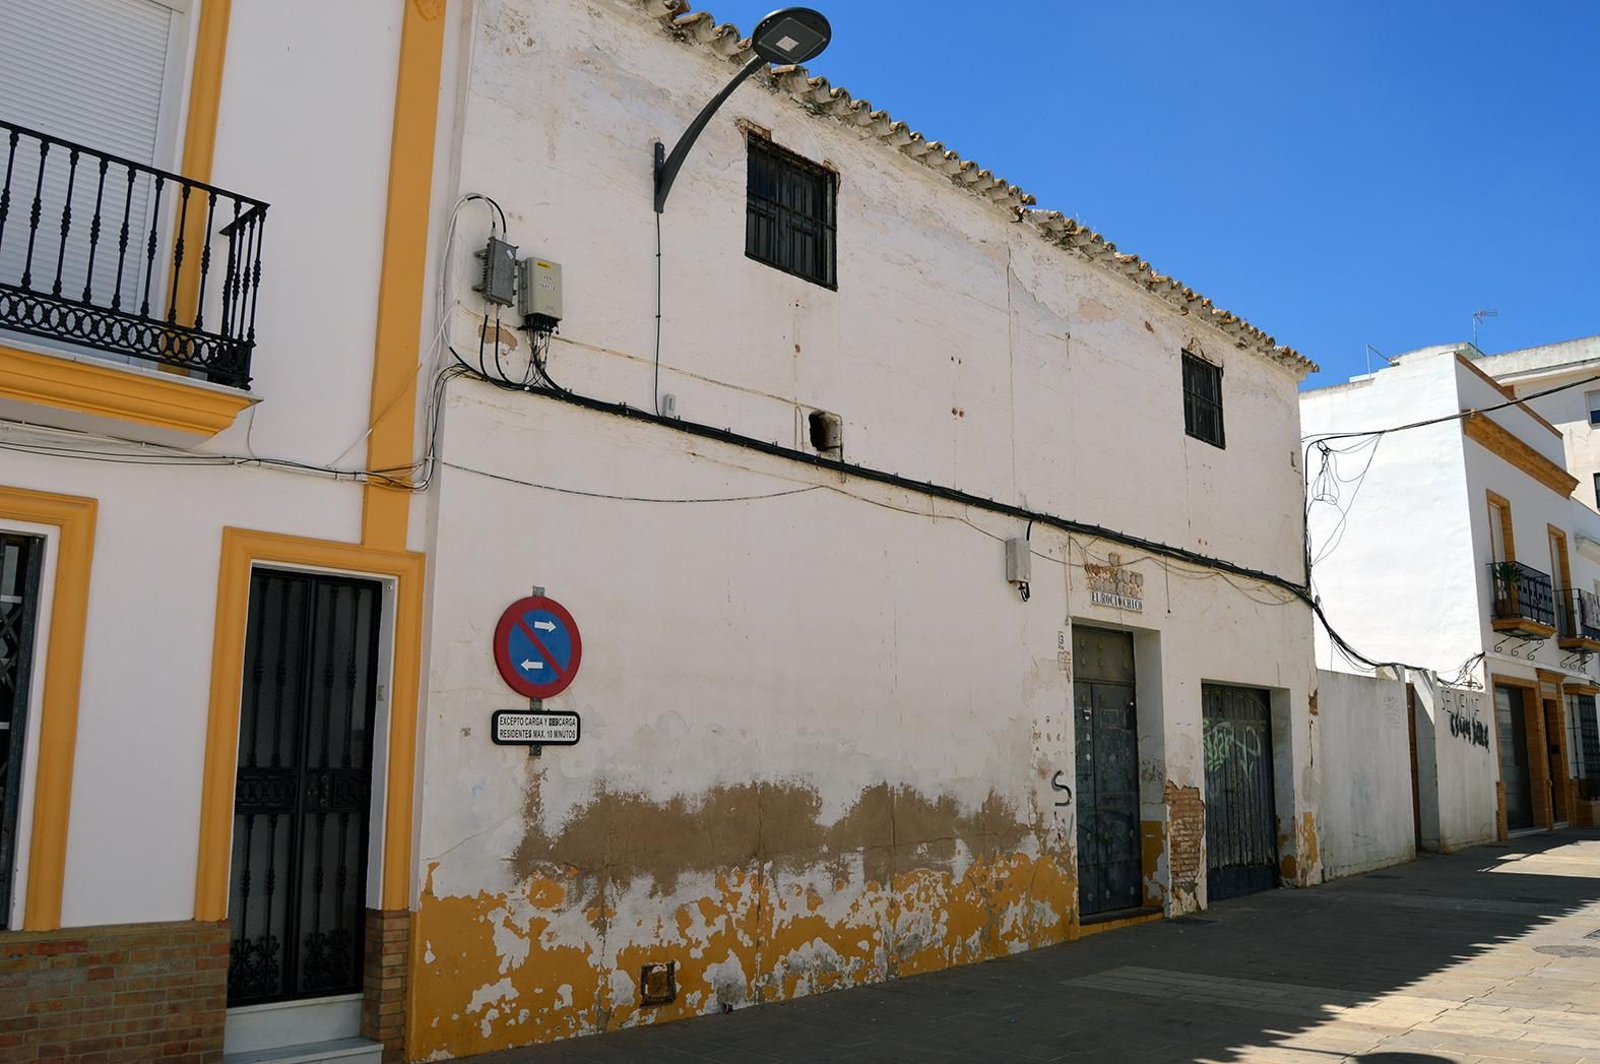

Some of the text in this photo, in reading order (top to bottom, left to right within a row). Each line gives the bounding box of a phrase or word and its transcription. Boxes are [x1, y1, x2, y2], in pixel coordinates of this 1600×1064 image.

[500, 716, 576, 727] EXCEPTO CARGA Y DESCARGA
[500, 729, 532, 739] RESIDENTES
[547, 730, 553, 739] 10
[554, 730, 576, 739] MINUTOS
